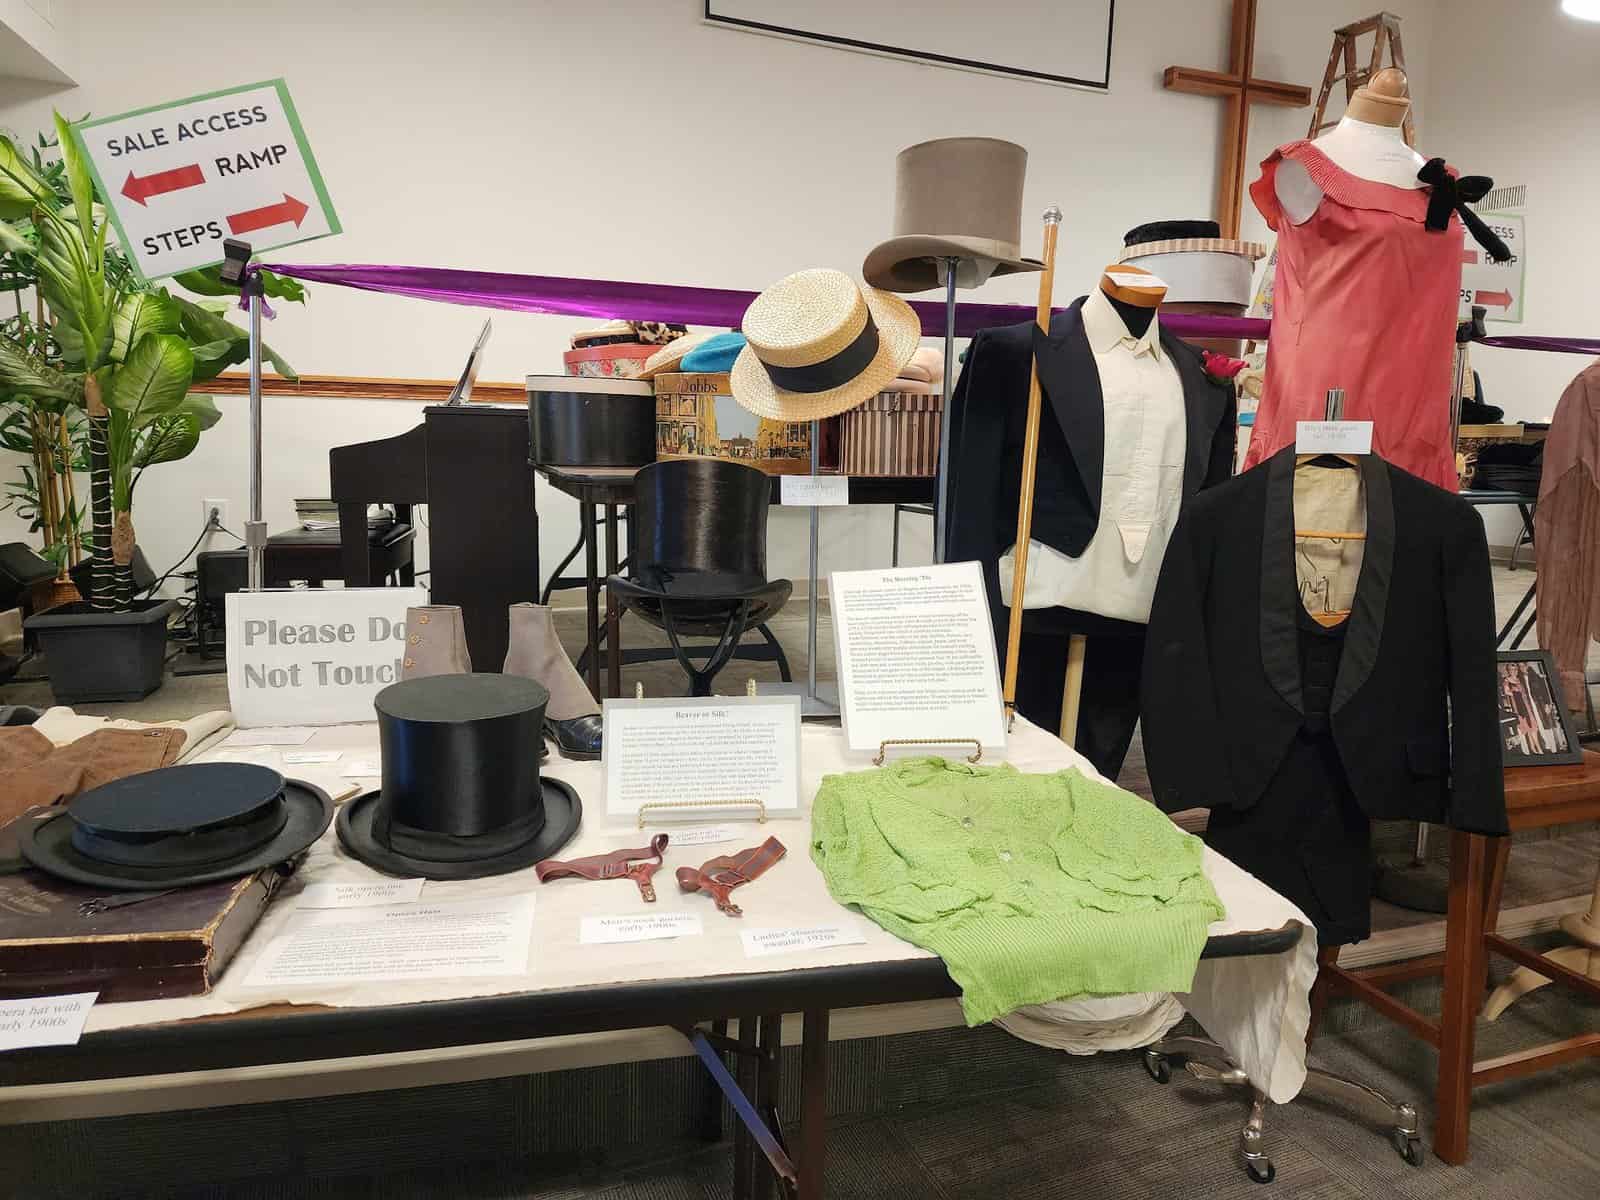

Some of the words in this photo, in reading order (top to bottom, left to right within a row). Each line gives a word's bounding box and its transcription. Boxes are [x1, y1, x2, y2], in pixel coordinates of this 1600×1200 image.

[106, 127, 169, 157] SALE
[177, 105, 268, 142] ACCESS
[215, 144, 288, 177] RAMP
[143, 221, 223, 256] STEPS
[1485, 251, 1517, 267] RP
[244, 619, 356, 646] Please
[368, 616, 407, 642] Do
[244, 663, 302, 689] Not
[53, 1000, 81, 1013] with
[0, 1019, 22, 1033] arly
